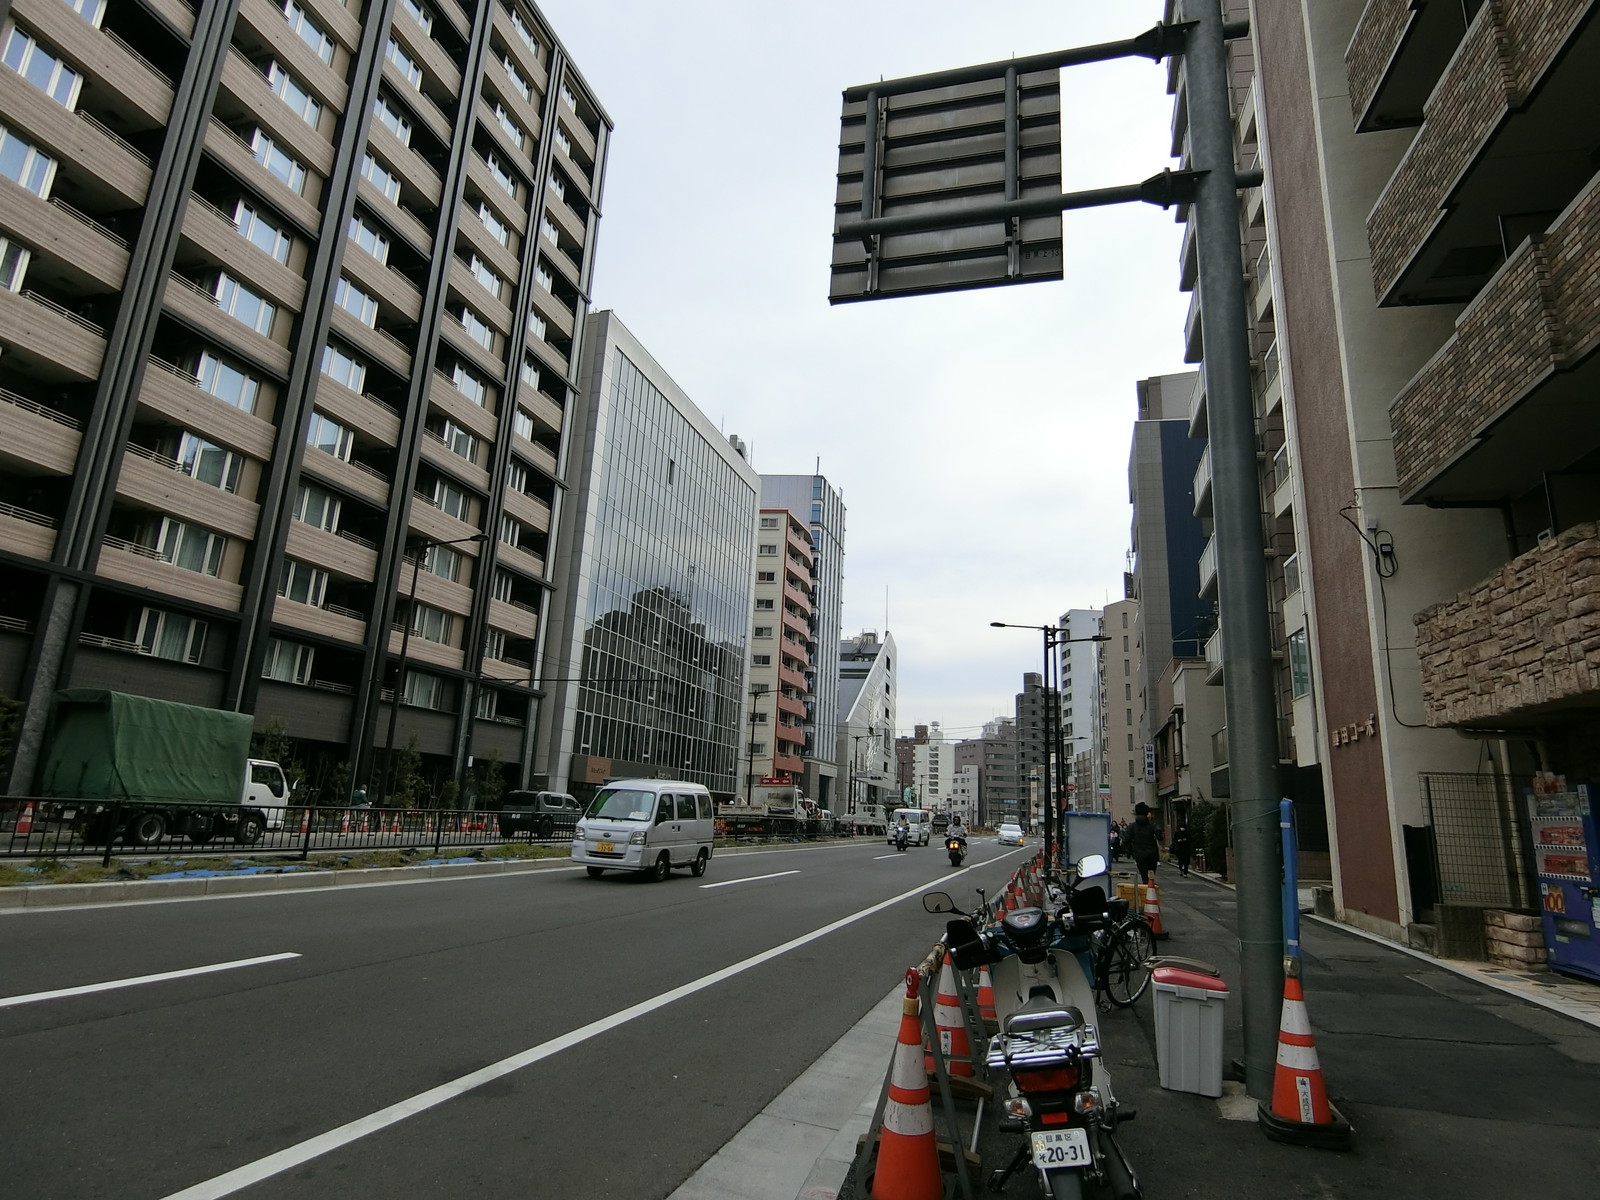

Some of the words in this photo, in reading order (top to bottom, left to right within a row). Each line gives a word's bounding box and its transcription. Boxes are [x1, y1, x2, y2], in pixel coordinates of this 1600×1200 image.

[1046, 1132, 1073, 1143] 目黒区
[1047, 1144, 1086, 1163] 20-31
